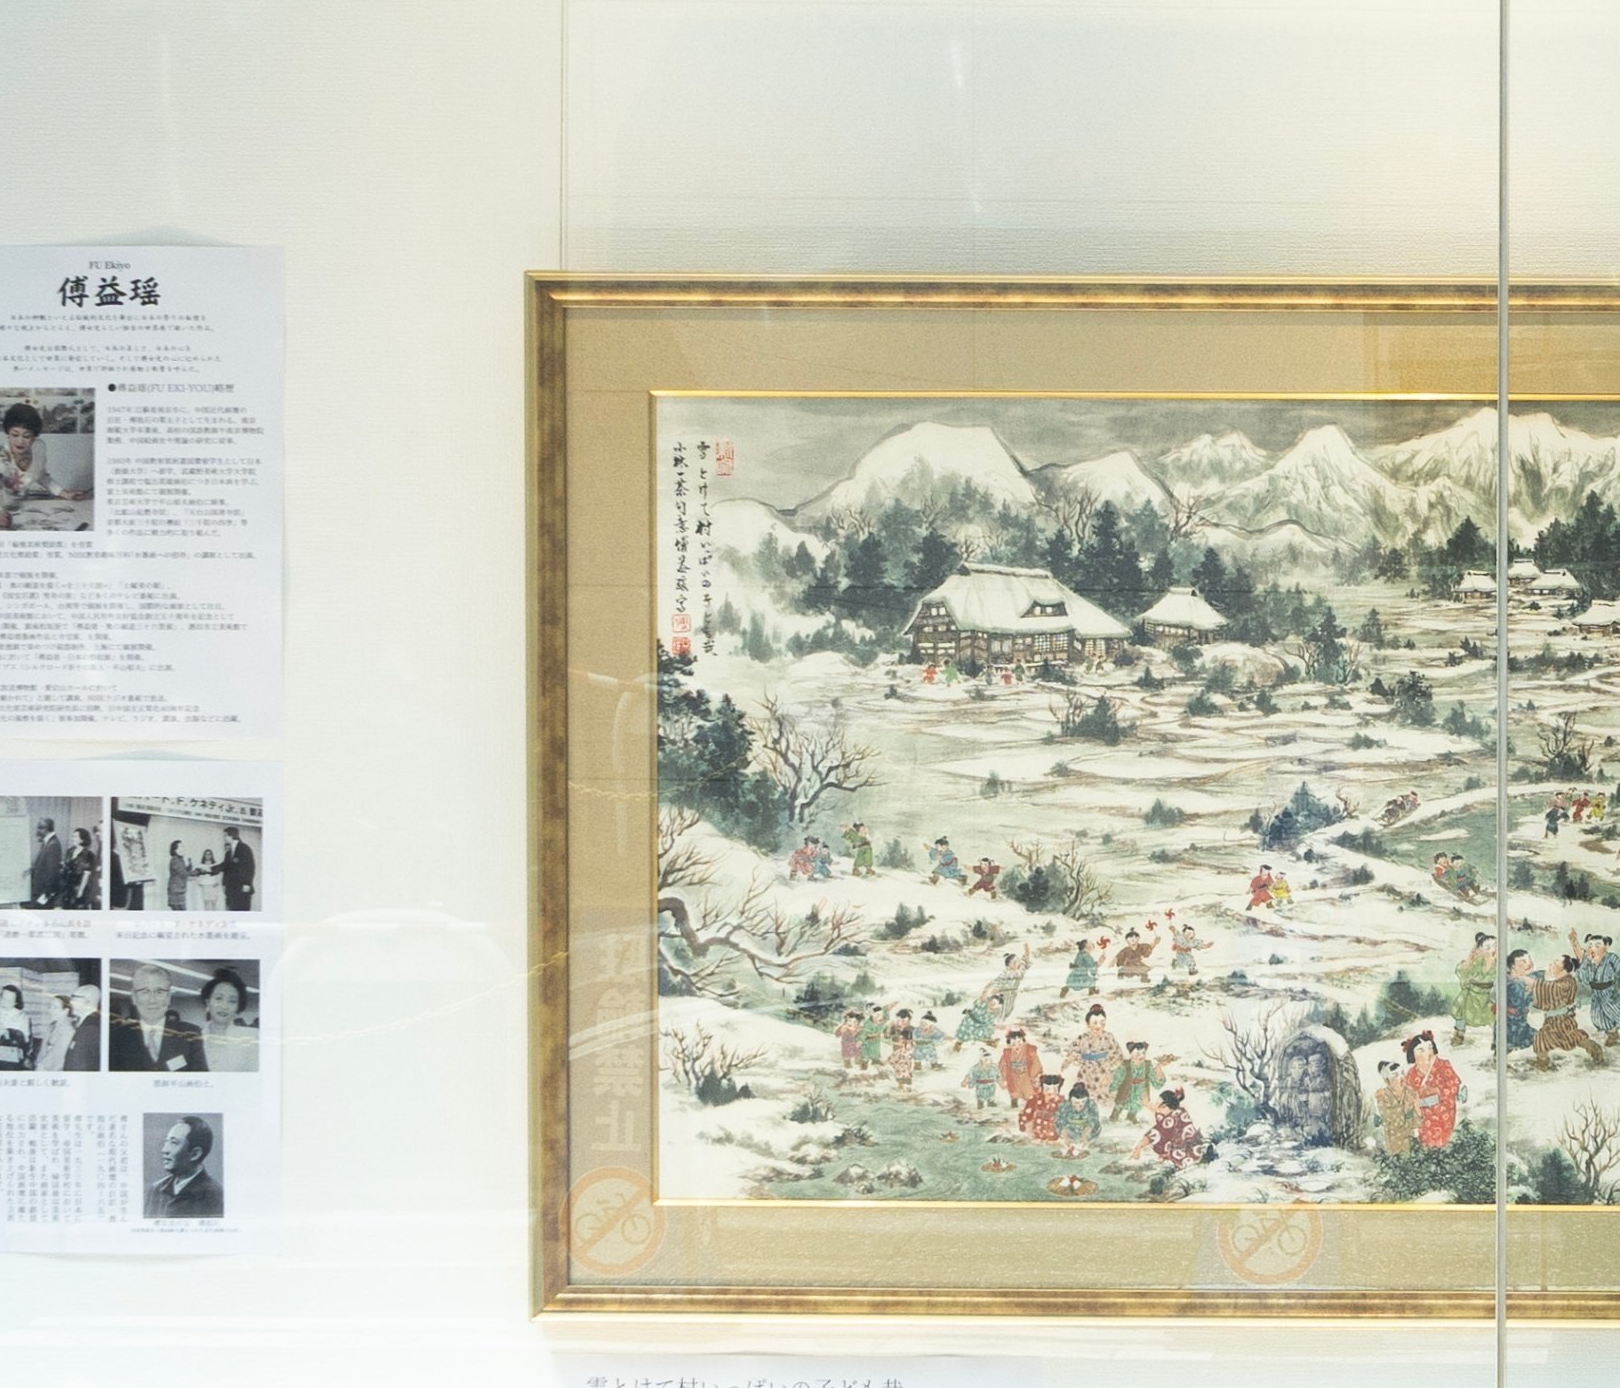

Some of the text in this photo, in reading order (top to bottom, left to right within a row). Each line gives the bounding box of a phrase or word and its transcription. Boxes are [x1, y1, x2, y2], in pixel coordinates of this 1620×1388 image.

[88, 261, 131, 271] FU Ekiyo
[57, 275, 161, 308] 傅益瑶
